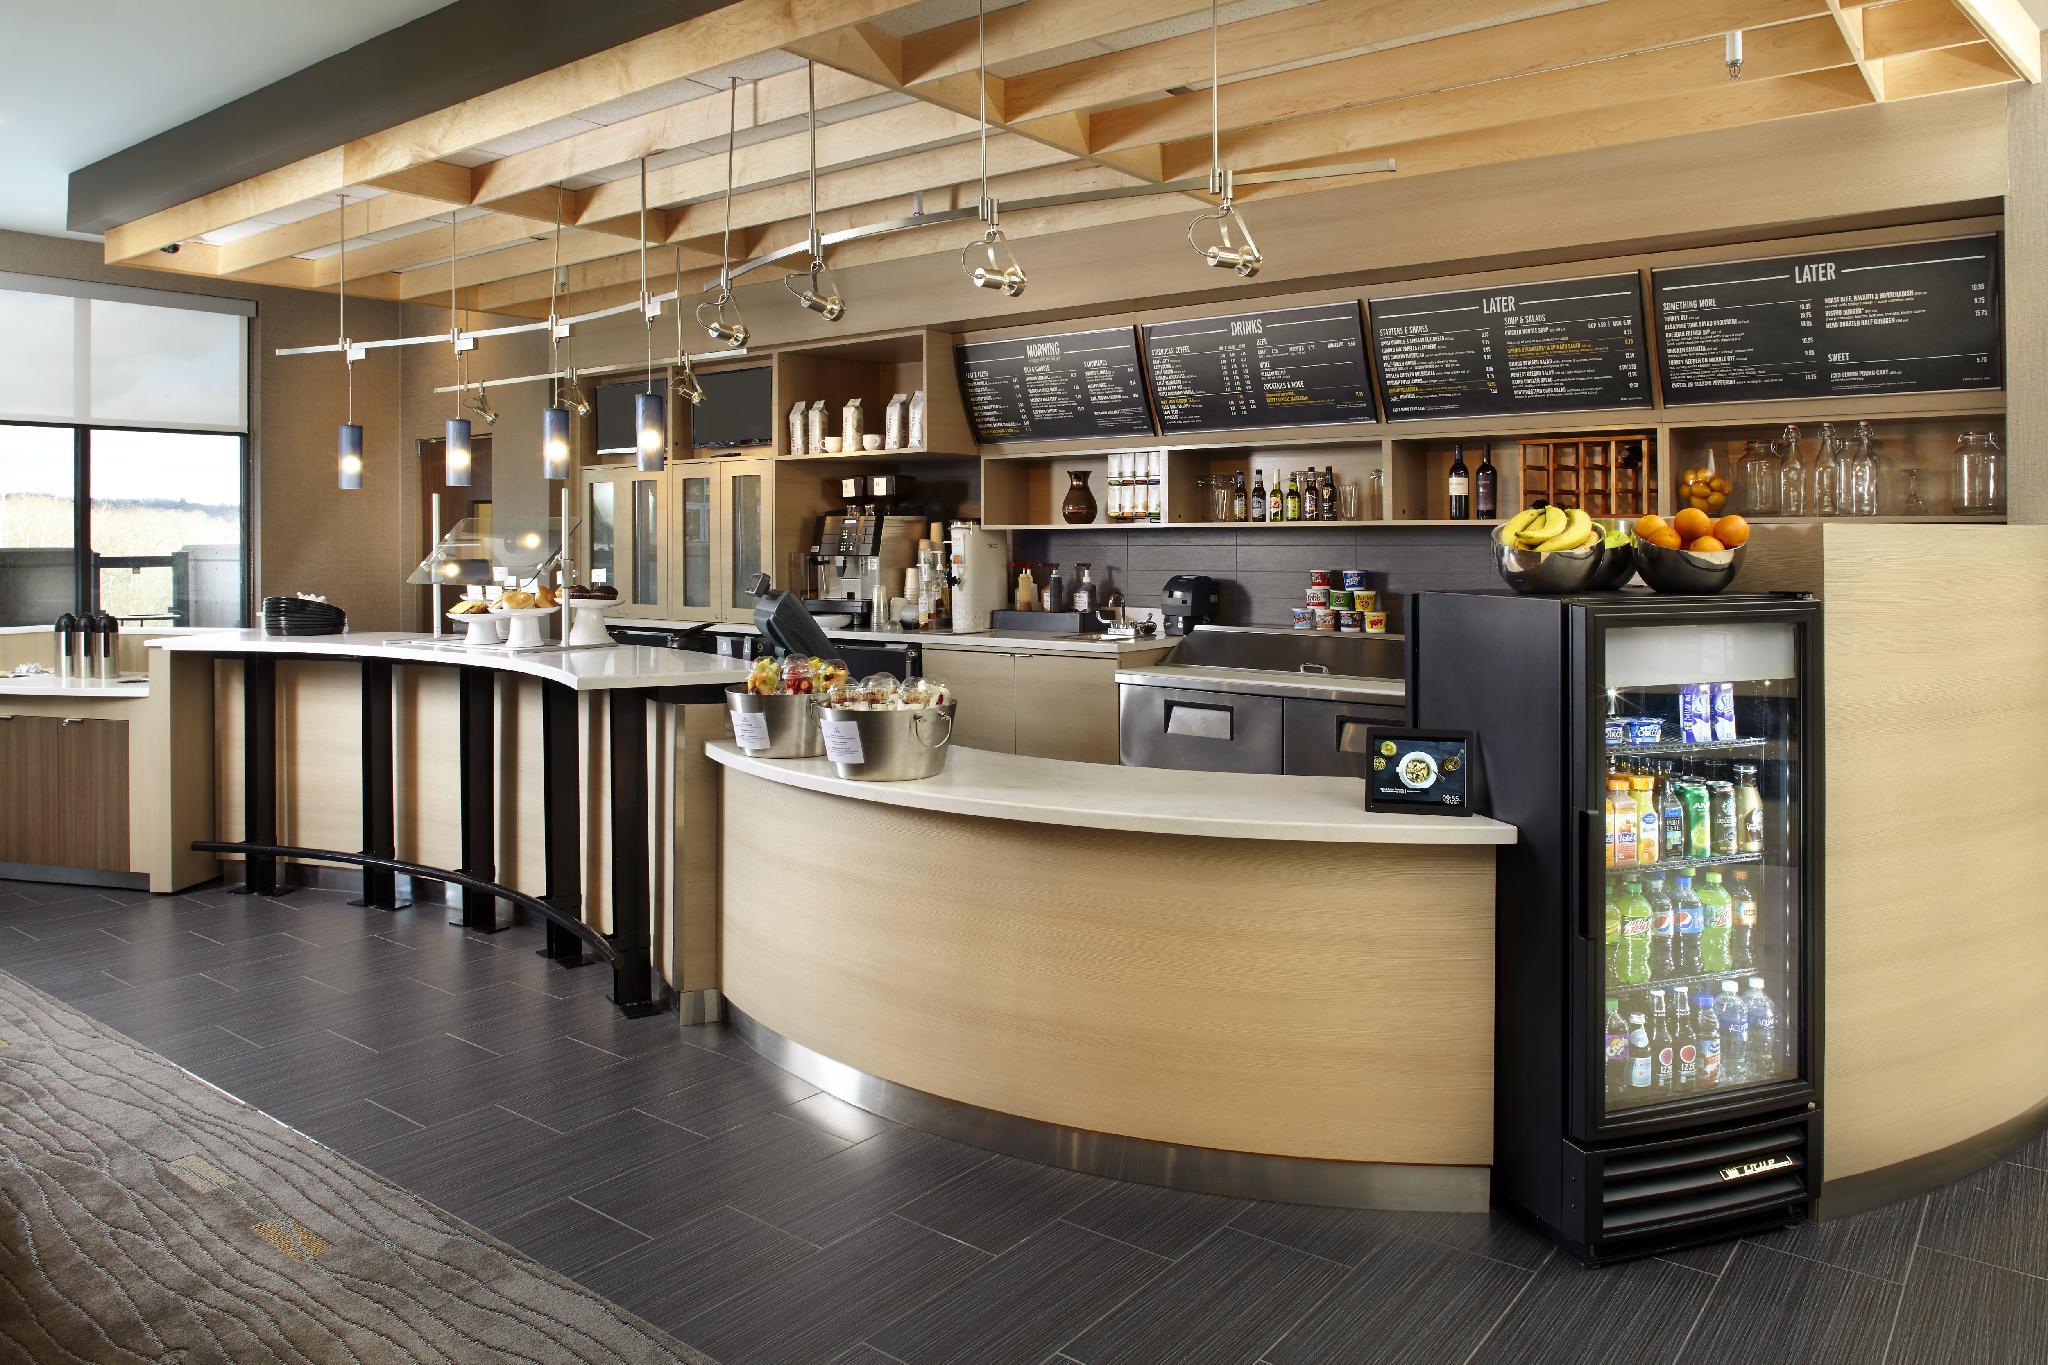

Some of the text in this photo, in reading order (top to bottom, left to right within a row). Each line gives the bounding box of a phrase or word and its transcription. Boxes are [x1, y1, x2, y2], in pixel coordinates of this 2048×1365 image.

[1795, 262, 1837, 284] LATER
[1483, 296, 1516, 315] LATER
[1662, 298, 1717, 311] SOMETHING MORE
[1231, 319, 1263, 337] DRINKS
[1026, 342, 1060, 358] MORNING
[1827, 352, 1850, 362] SWEET
[1681, 1062, 1696, 1071] IZZE
